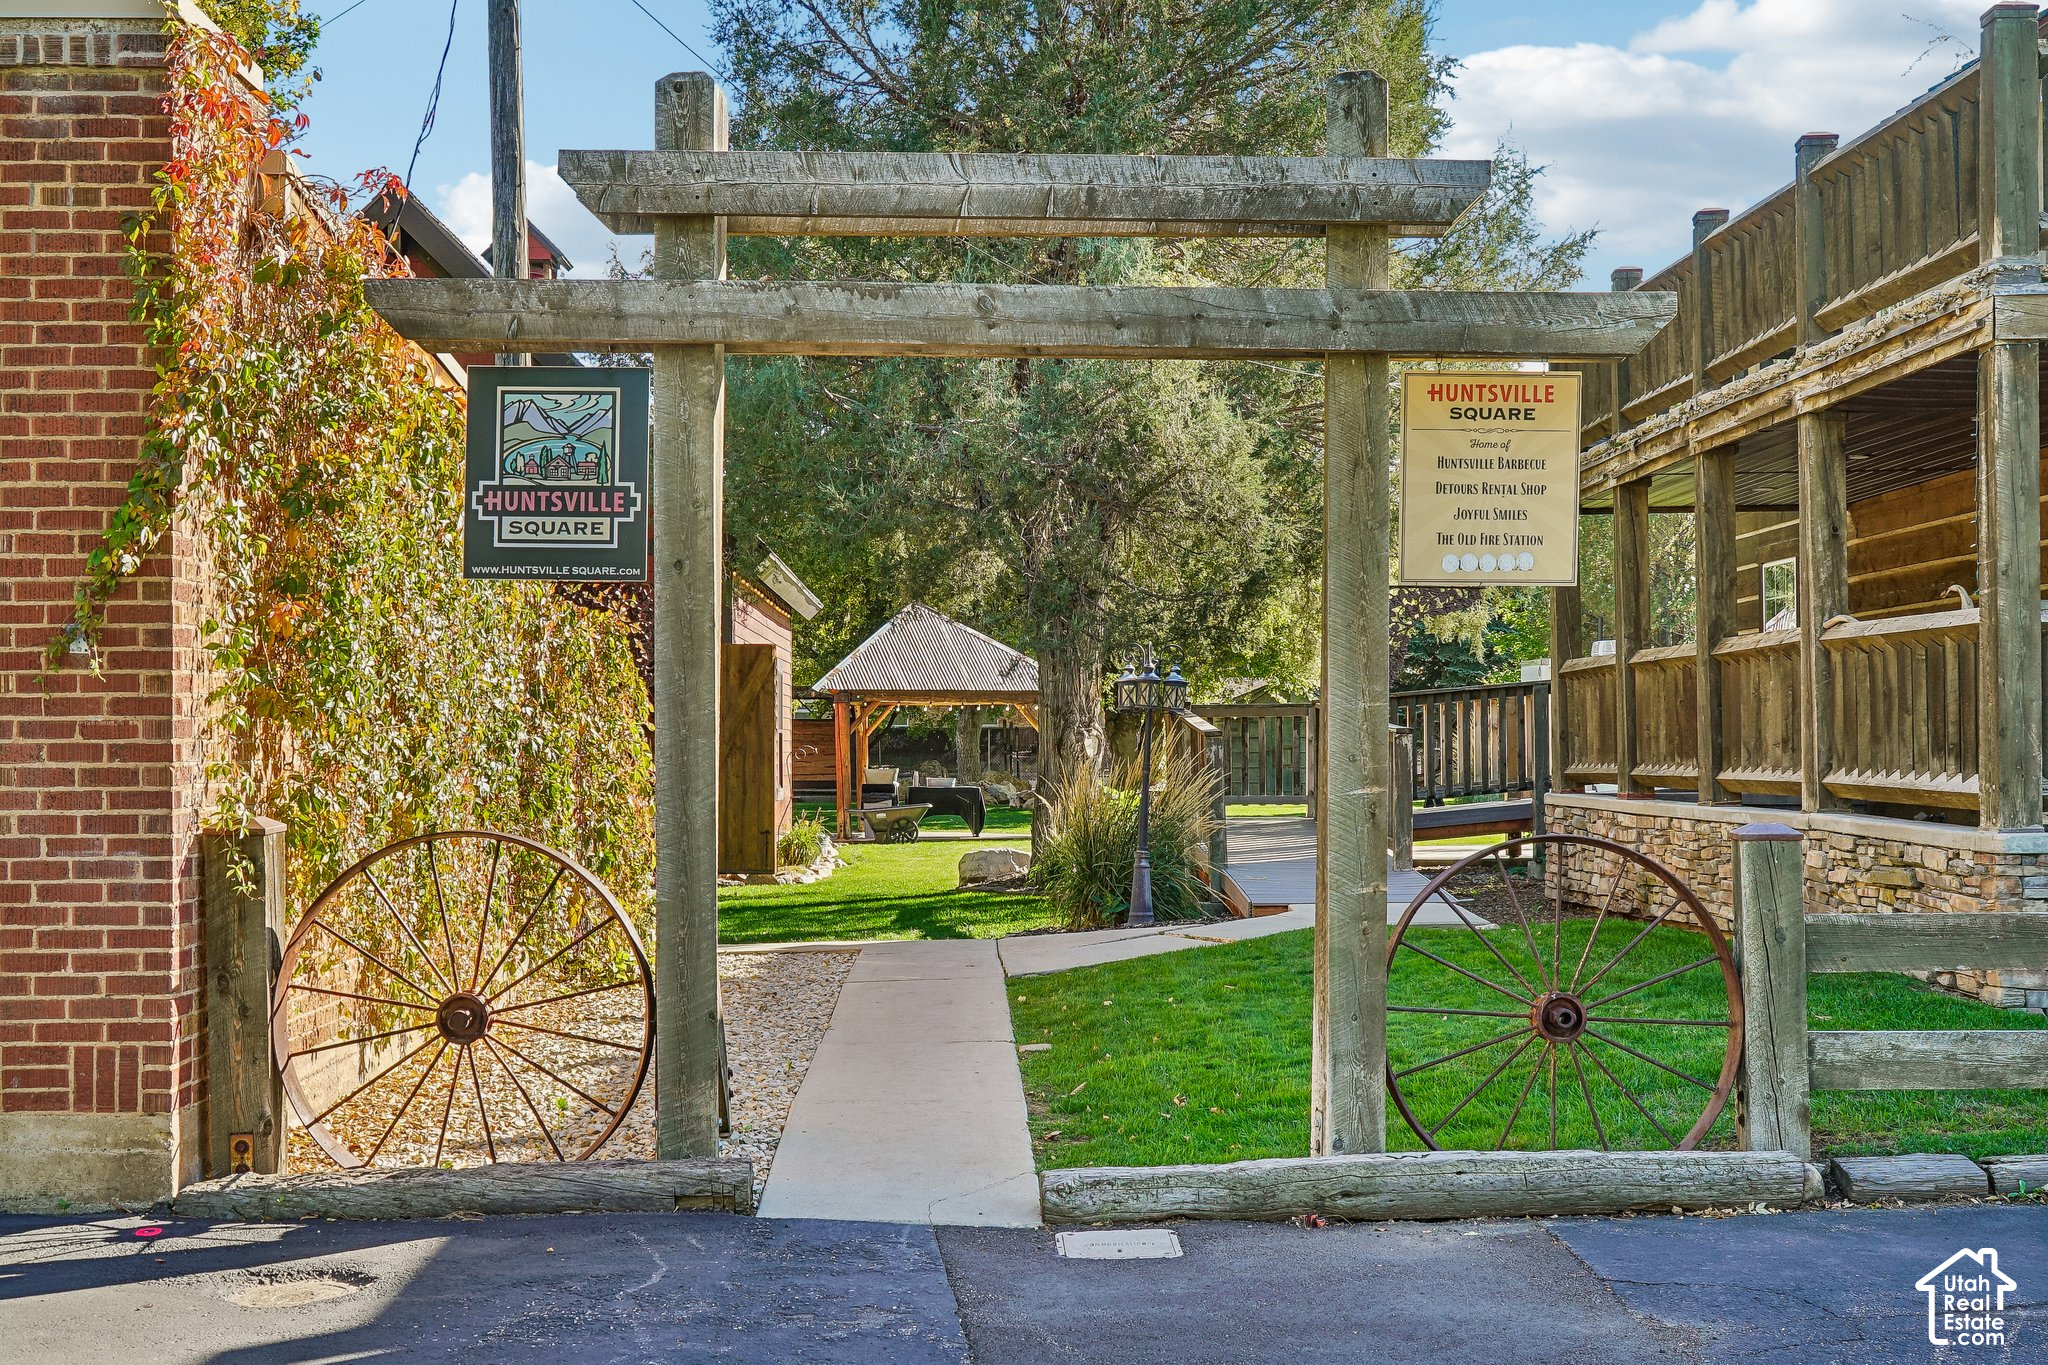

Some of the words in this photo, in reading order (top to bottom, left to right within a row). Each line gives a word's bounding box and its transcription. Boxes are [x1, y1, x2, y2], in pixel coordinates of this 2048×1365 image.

[1427, 383, 1555, 403] HUNTSVILLE
[1449, 407, 1536, 421] SQUARE
[1469, 438, 1499, 449] Home
[1500, 439, 1512, 452] of
[483, 490, 625, 513] HUNTSVILLE
[508, 521, 604, 536] SQUARE
